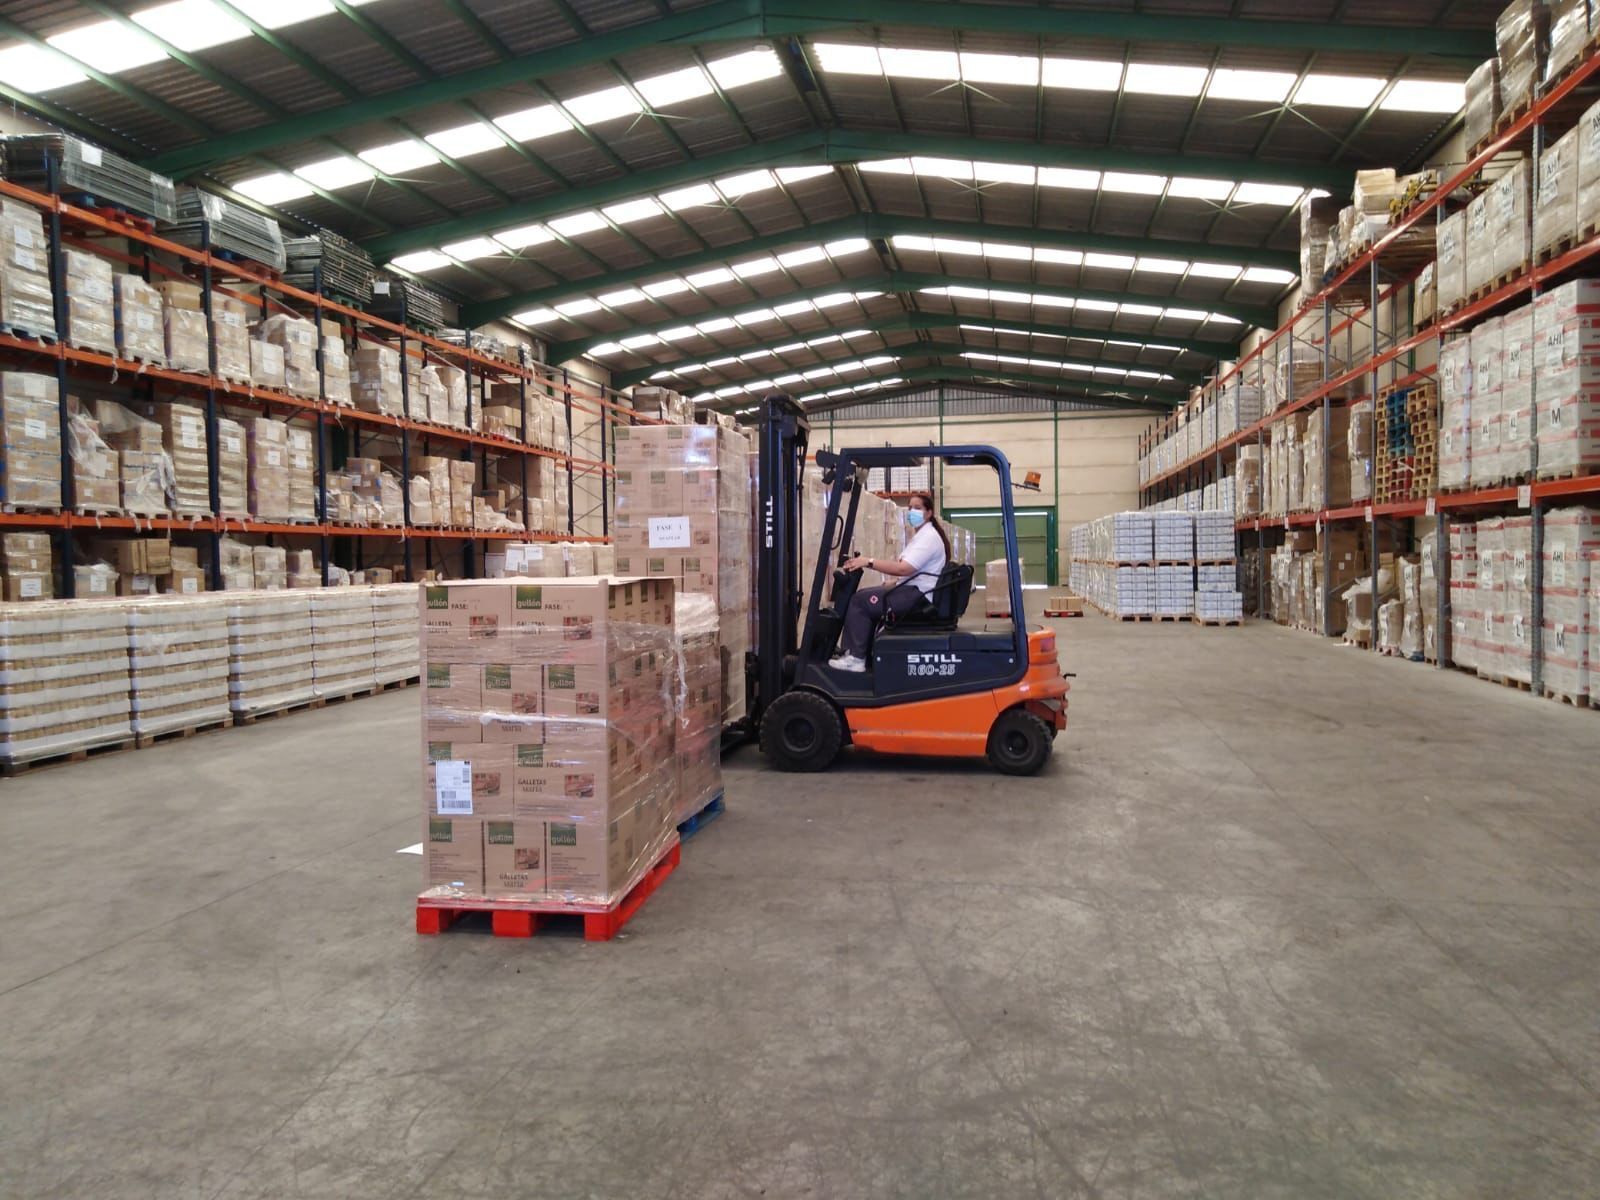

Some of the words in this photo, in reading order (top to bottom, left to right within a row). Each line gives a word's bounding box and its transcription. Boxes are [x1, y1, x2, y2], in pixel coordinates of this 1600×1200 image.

[1551, 407, 1561, 425] M
[517, 599, 541, 609] gullón
[907, 653, 962, 663] STILL
